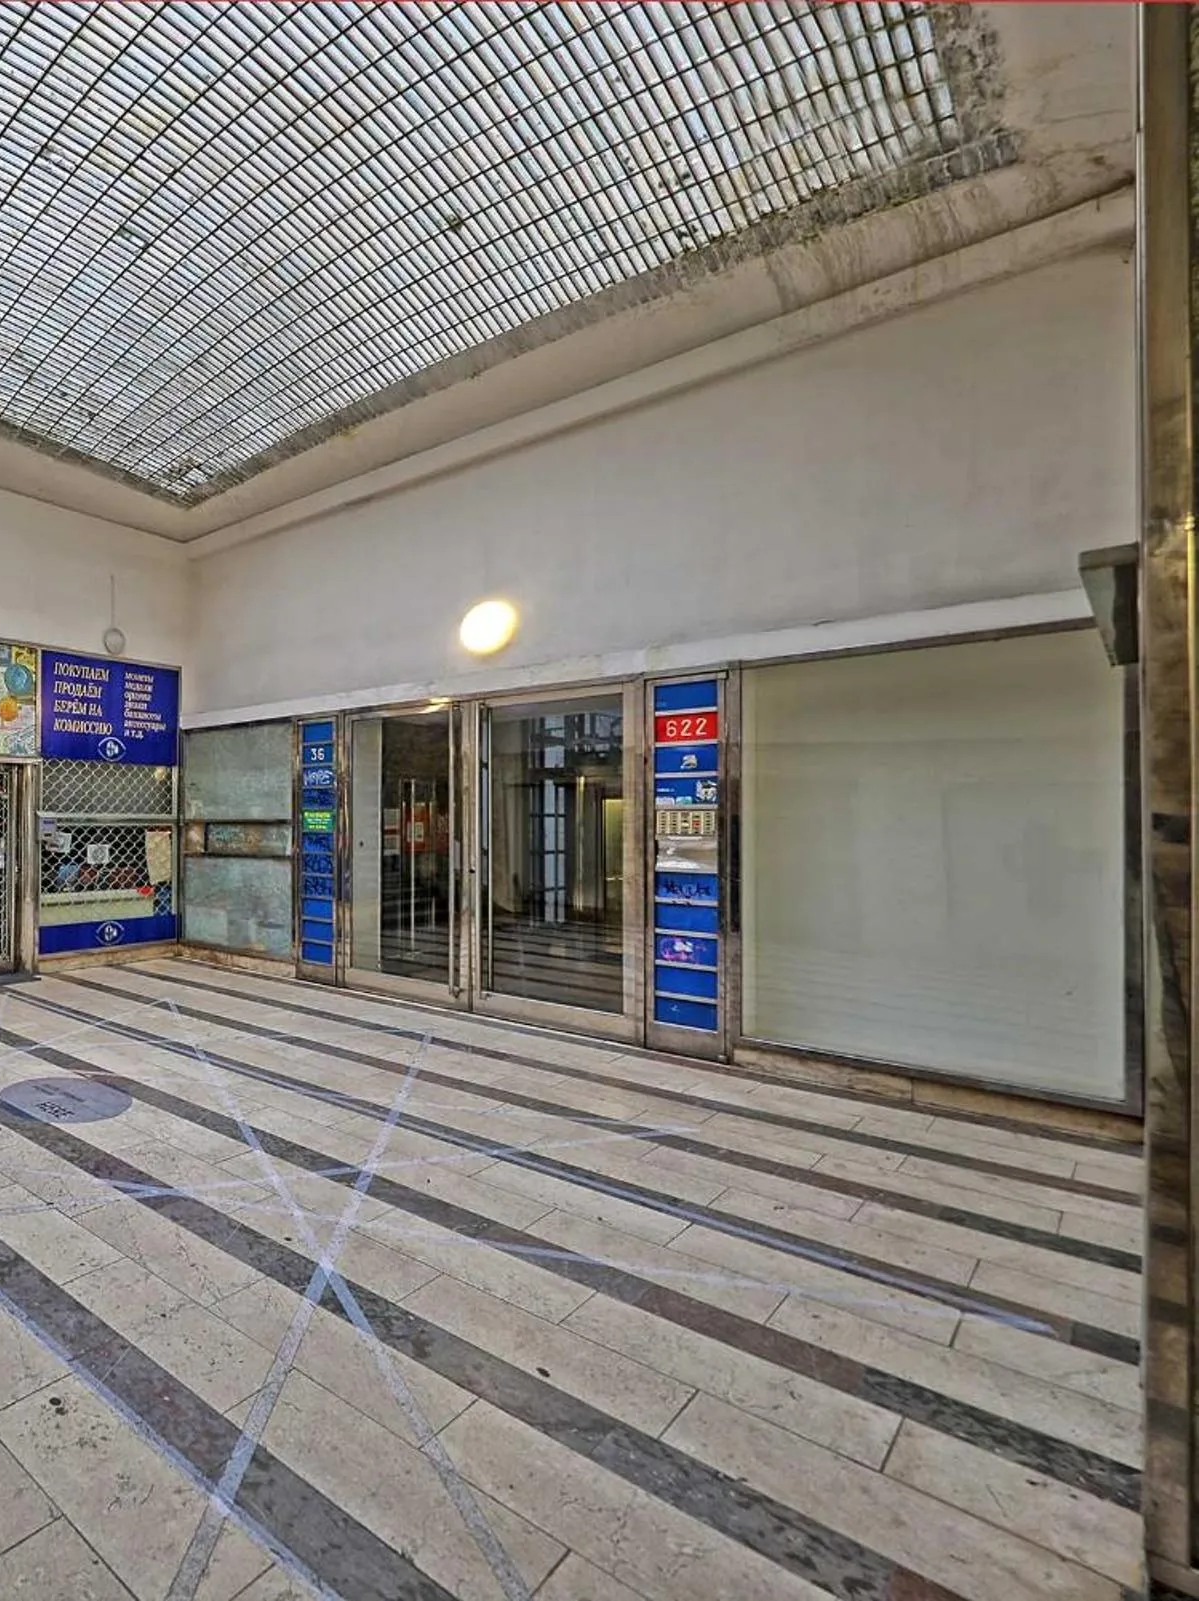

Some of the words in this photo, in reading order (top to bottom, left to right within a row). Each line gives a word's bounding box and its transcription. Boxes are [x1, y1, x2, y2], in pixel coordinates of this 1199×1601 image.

[54, 662, 109, 682] ПОКУПАЕМ
[54, 681, 102, 698] ПРОДАЁМ
[54, 699, 87, 715] БЕРЁМ
[88, 702, 103, 717] НА
[54, 718, 113, 735] КОМИССИЮ
[665, 717, 708, 737] 622
[310, 747, 325, 761] 36
